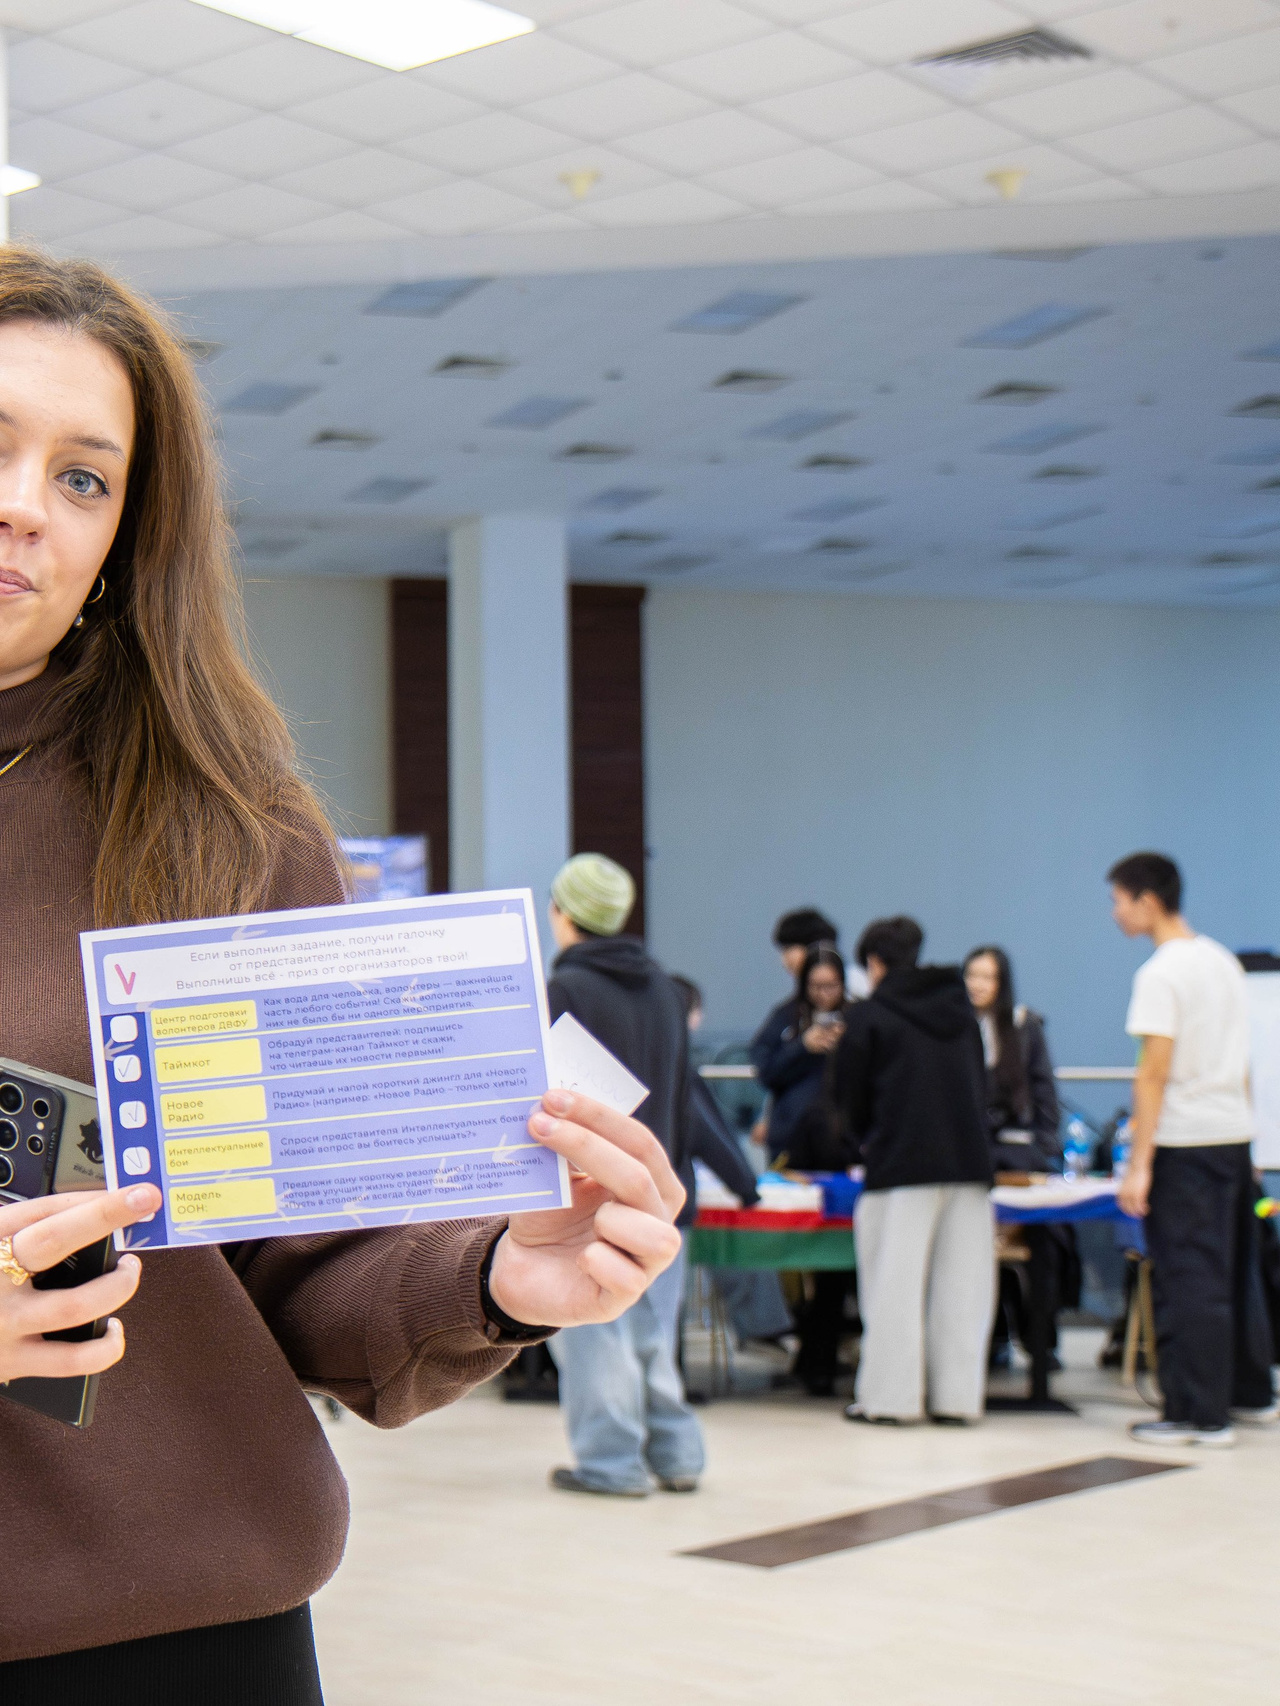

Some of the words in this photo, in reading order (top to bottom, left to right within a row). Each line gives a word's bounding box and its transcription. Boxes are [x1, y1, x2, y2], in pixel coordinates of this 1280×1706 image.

[190, 952, 220, 962] Если
[223, 944, 286, 958] выполнил
[290, 938, 345, 951] задание,
[349, 933, 393, 946] получи
[398, 928, 446, 941] галочку
[176, 975, 251, 990] Выполнишь
[255, 972, 276, 982] всё
[288, 968, 318, 979] приз
[322, 967, 335, 975] от
[338, 957, 433, 974] организаторов
[438, 952, 469, 963] твой!
[229, 962, 242, 971] от
[246, 953, 339, 969] представителя
[263, 998, 282, 1006] Как
[311, 994, 329, 1002] для
[332, 988, 382, 999] человека,
[385, 982, 440, 993] волонтеры
[455, 975, 513, 986] важнейшая
[264, 1008, 292, 1017] часть
[294, 1005, 332, 1014] любого
[335, 998, 381, 1010] события!
[383, 996, 416, 1005] Скажи
[419, 989, 482, 1001] волонтерам,
[484, 987, 501, 995] что
[503, 985, 521, 993] без
[189, 1009, 247, 1020] подготовки
[265, 1020, 284, 1028] них
[302, 1016, 328, 1024] было
[331, 1013, 345, 1021] бы
[348, 1012, 361, 1020] ни
[364, 1009, 400, 1019] одного
[156, 1023, 216, 1035] волонтеров
[218, 1019, 248, 1030] ДВФУ
[267, 1037, 313, 1049] Обрадуй
[404, 1023, 463, 1034] подпишись
[270, 1063, 287, 1071] что
[289, 1059, 333, 1069] читаешь
[350, 1053, 392, 1063] новости
[395, 1046, 445, 1059] первыми!
[284, 1044, 365, 1059] телеграм-канал
[367, 1040, 409, 1050] Таймкот
[421, 1035, 456, 1044] скажи,
[163, 1059, 211, 1071] Таймкот
[272, 1086, 325, 1100] Придумай
[337, 1082, 369, 1093] напой
[371, 1077, 420, 1089] короткий
[422, 1074, 461, 1085] джингл
[463, 1072, 482, 1080] для
[485, 1068, 527, 1078] «Нового
[273, 1101, 310, 1110] Радио»
[373, 1091, 410, 1101] «Новое
[413, 1087, 445, 1096] Радио
[455, 1082, 490, 1092] только
[166, 1101, 204, 1111] Новое
[168, 1113, 204, 1122] Радио
[279, 1145, 315, 1157] «Какой
[317, 1143, 354, 1153] вопрос
[357, 1141, 371, 1149] вы
[374, 1137, 415, 1147] боитесь
[417, 1131, 477, 1145] услышать?»
[280, 1136, 319, 1145] Спроси
[322, 1127, 398, 1142] представителя
[401, 1119, 497, 1133] Интеллектуальных
[168, 1142, 264, 1158] Интеллектуальные
[282, 1179, 331, 1190] Предложи
[334, 1176, 356, 1185] одну
[359, 1172, 403, 1182] короткую
[406, 1166, 461, 1179] резолюцию
[284, 1190, 320, 1199] которая
[323, 1186, 362, 1197] улучшит
[365, 1183, 394, 1191] жизнь
[397, 1177, 444, 1188] студентов
[446, 1173, 474, 1184] ДВФУ
[176, 1191, 221, 1201] Модель
[371, 1191, 403, 1200] всегда
[405, 1189, 432, 1198] будет
[177, 1204, 208, 1215] ООН:
